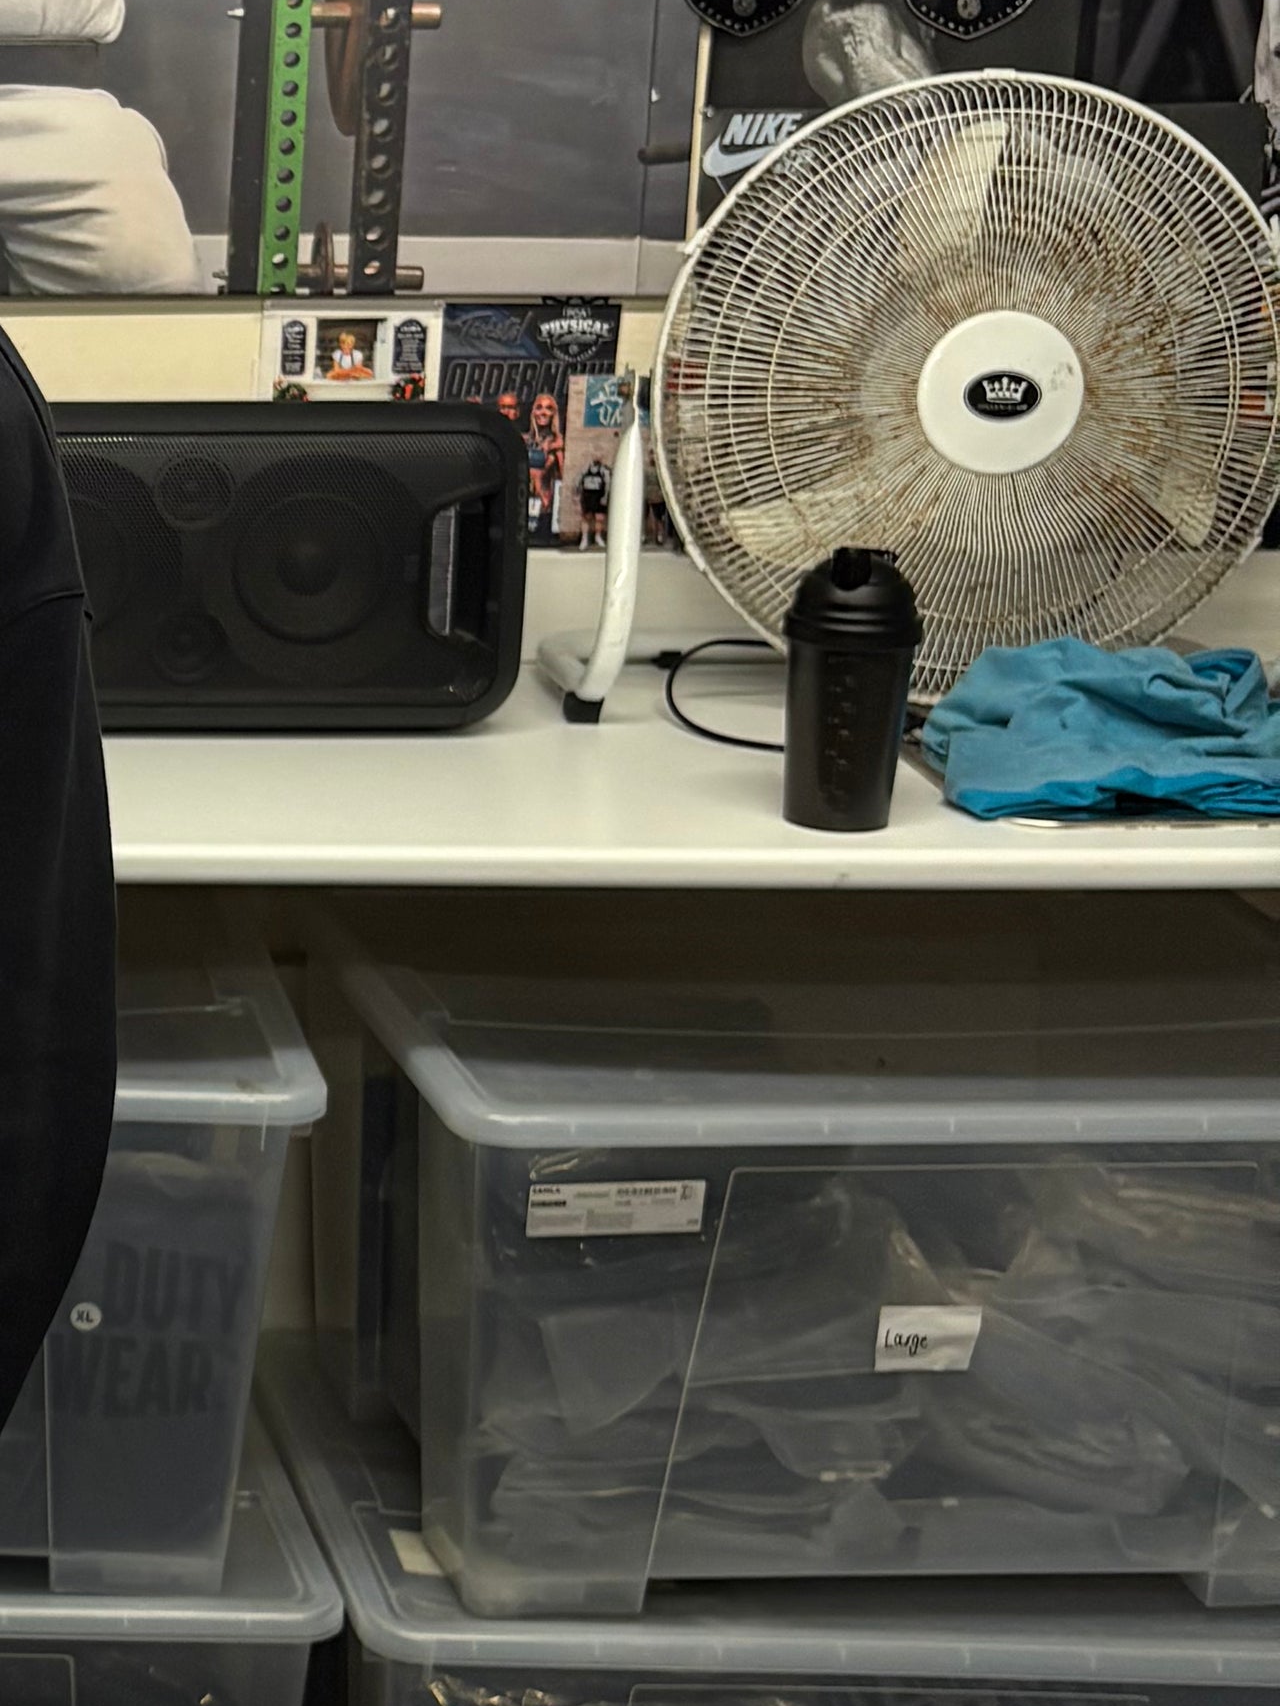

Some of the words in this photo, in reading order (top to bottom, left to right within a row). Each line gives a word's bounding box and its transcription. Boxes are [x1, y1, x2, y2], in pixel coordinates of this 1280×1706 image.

[721, 112, 803, 148] NIKE
[540, 319, 615, 337] PHYSICAL
[884, 1327, 929, 1358] Large
